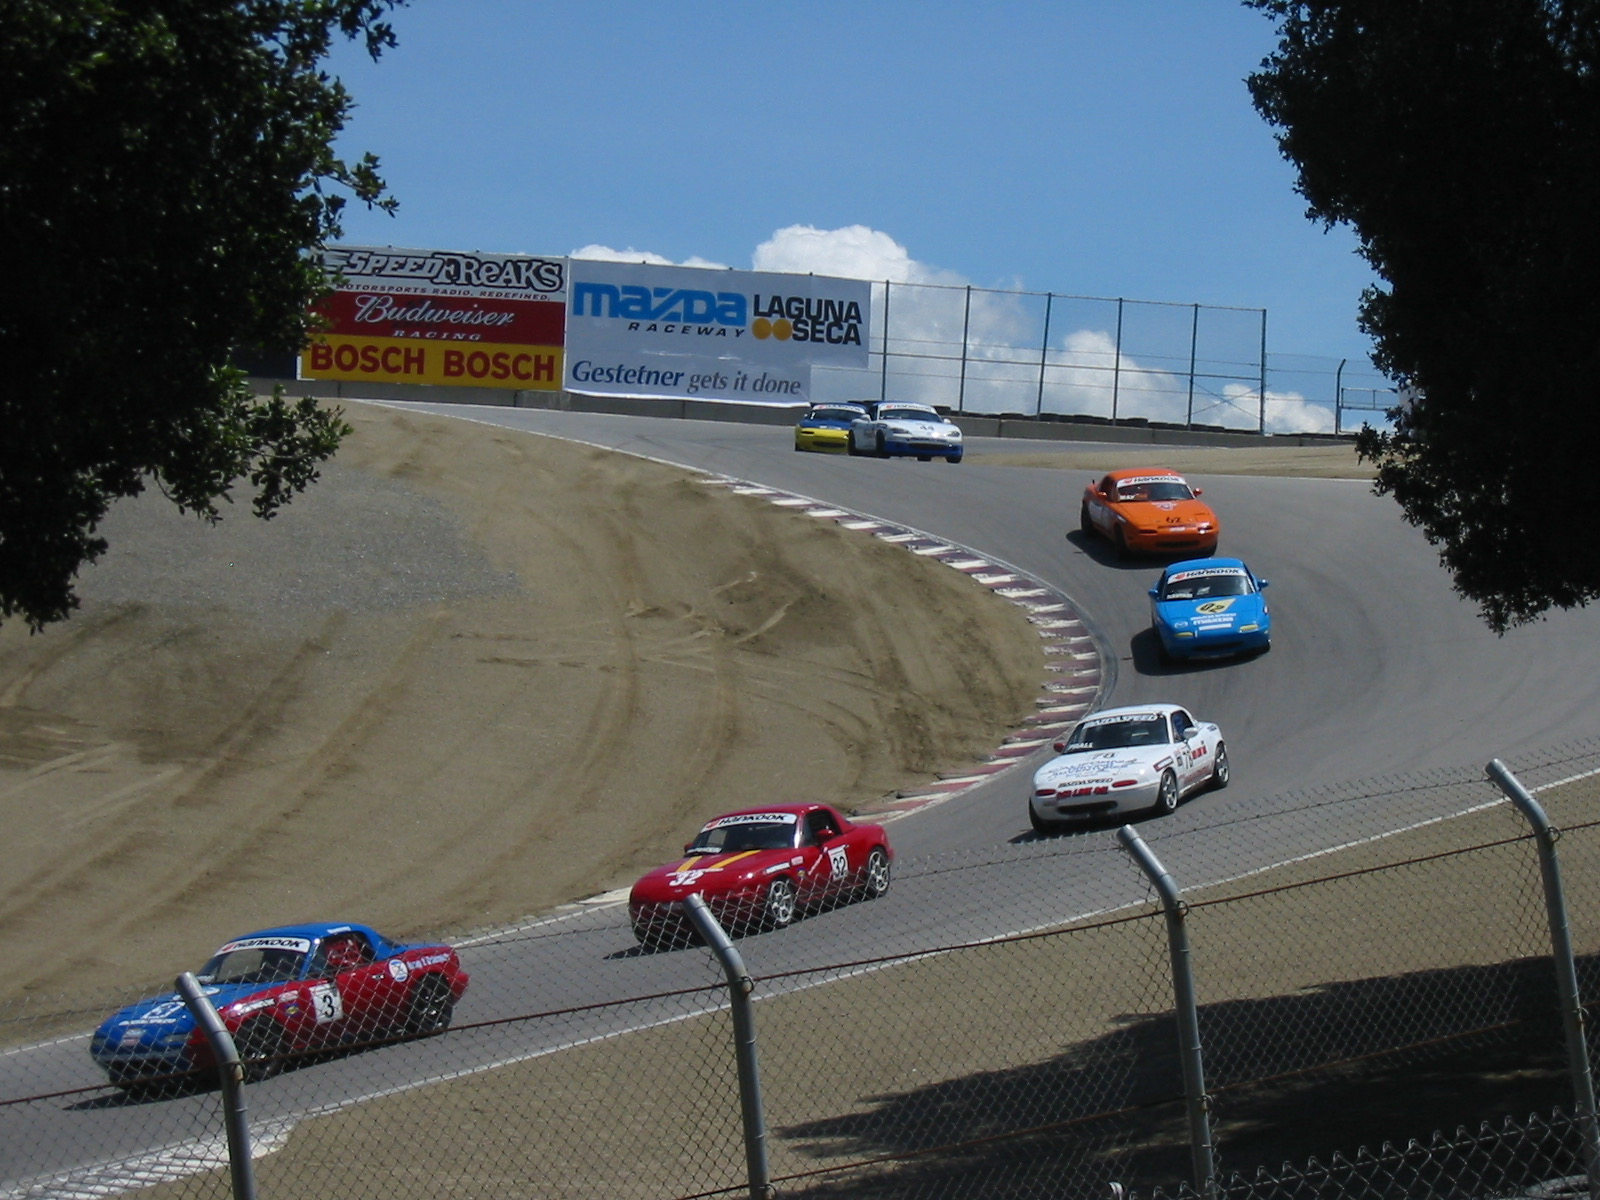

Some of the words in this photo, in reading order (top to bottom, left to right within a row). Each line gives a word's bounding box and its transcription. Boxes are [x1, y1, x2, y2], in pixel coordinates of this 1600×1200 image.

[355, 294, 515, 326] Budweiser
[753, 294, 862, 324] LAGUNA
[393, 330, 482, 341] RACING
[628, 322, 745, 338] RACEWAY
[791, 319, 862, 346] SECA
[310, 344, 425, 375] BOSCH
[443, 348, 555, 381] BOSCH
[571, 360, 684, 387] Gestetner
[687, 373, 728, 394] gets
[733, 371, 748, 391] it
[751, 372, 801, 395] done
[833, 854, 847, 875] 32
[669, 869, 704, 887] 32
[322, 994, 336, 1019] 3
